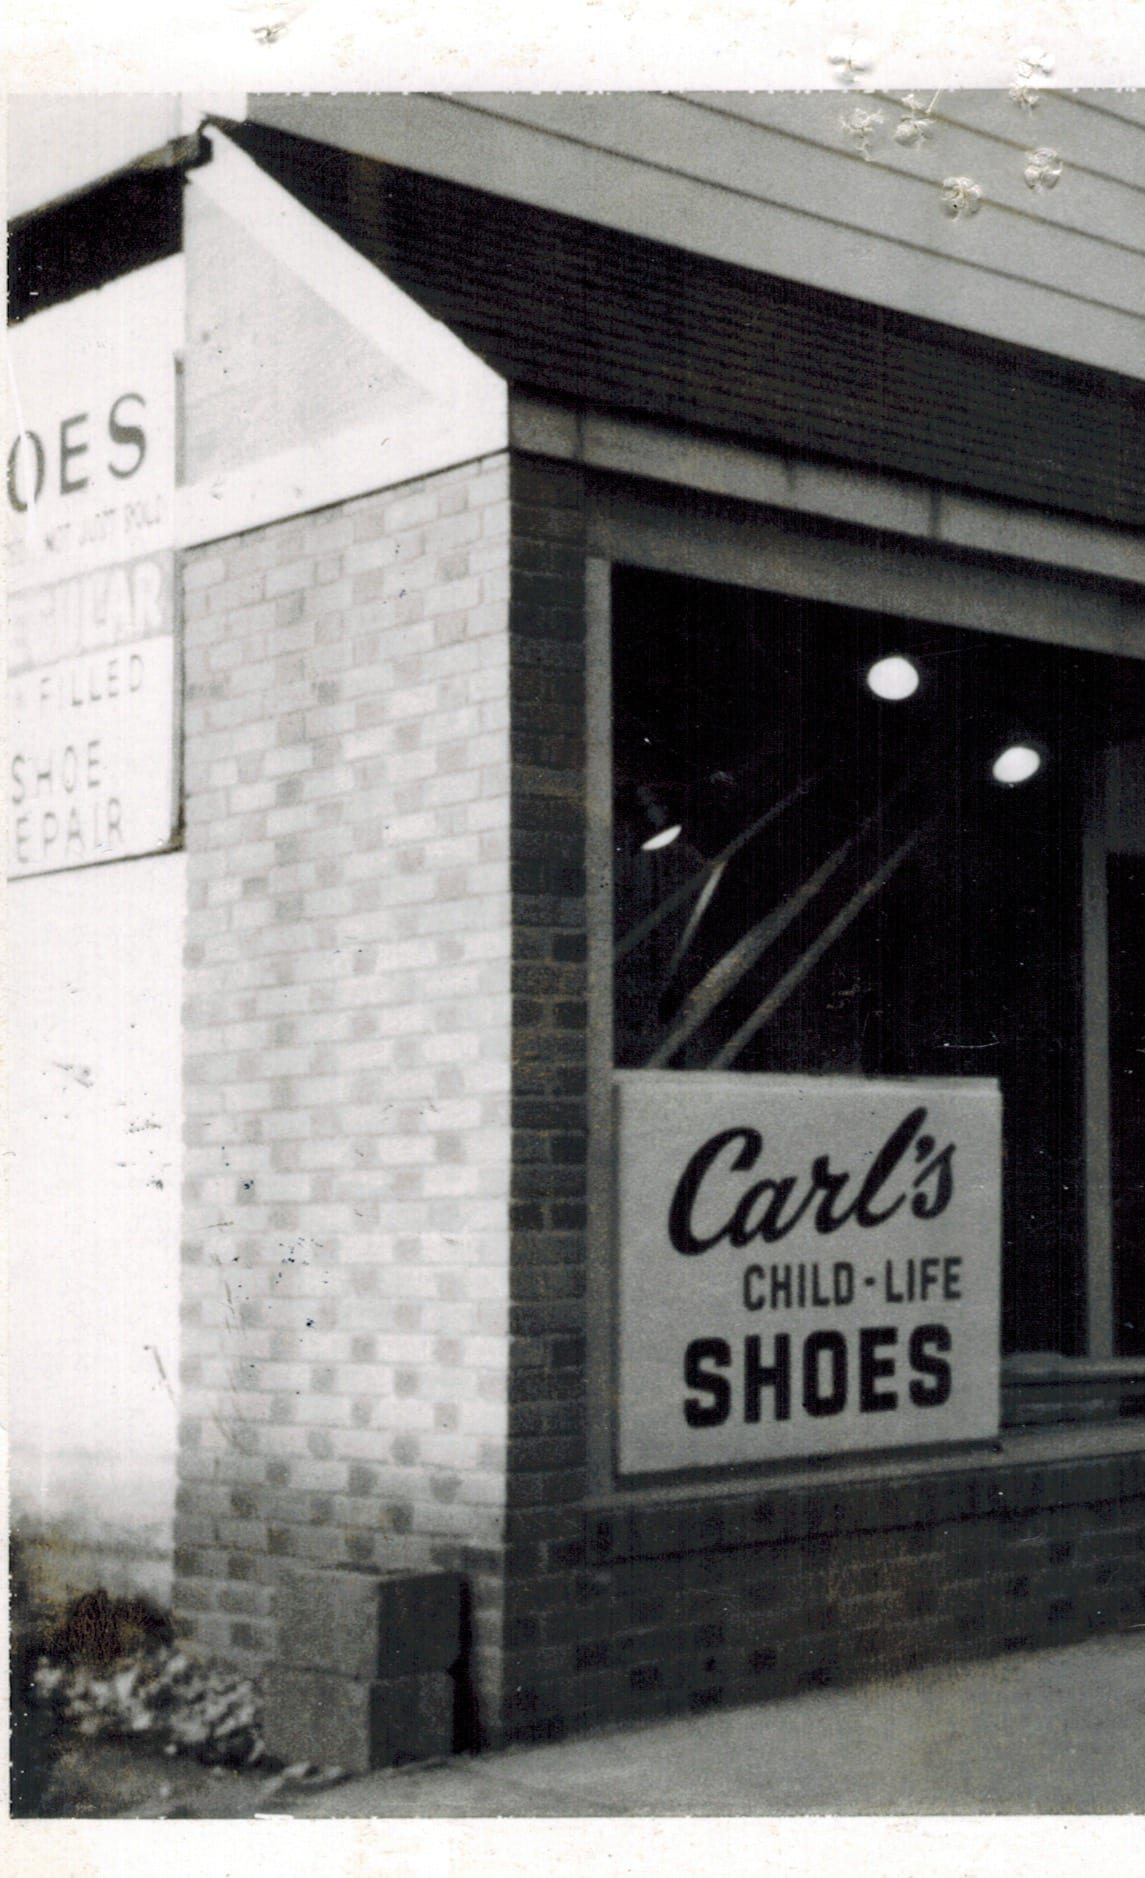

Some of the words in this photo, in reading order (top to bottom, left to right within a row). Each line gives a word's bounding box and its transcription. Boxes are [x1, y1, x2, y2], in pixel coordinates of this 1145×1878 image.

[40, 654, 144, 710] FILLED
[12, 739, 100, 806] SHOE
[667, 1106, 957, 1257] Carl's
[683, 1323, 953, 1429] SHOES
